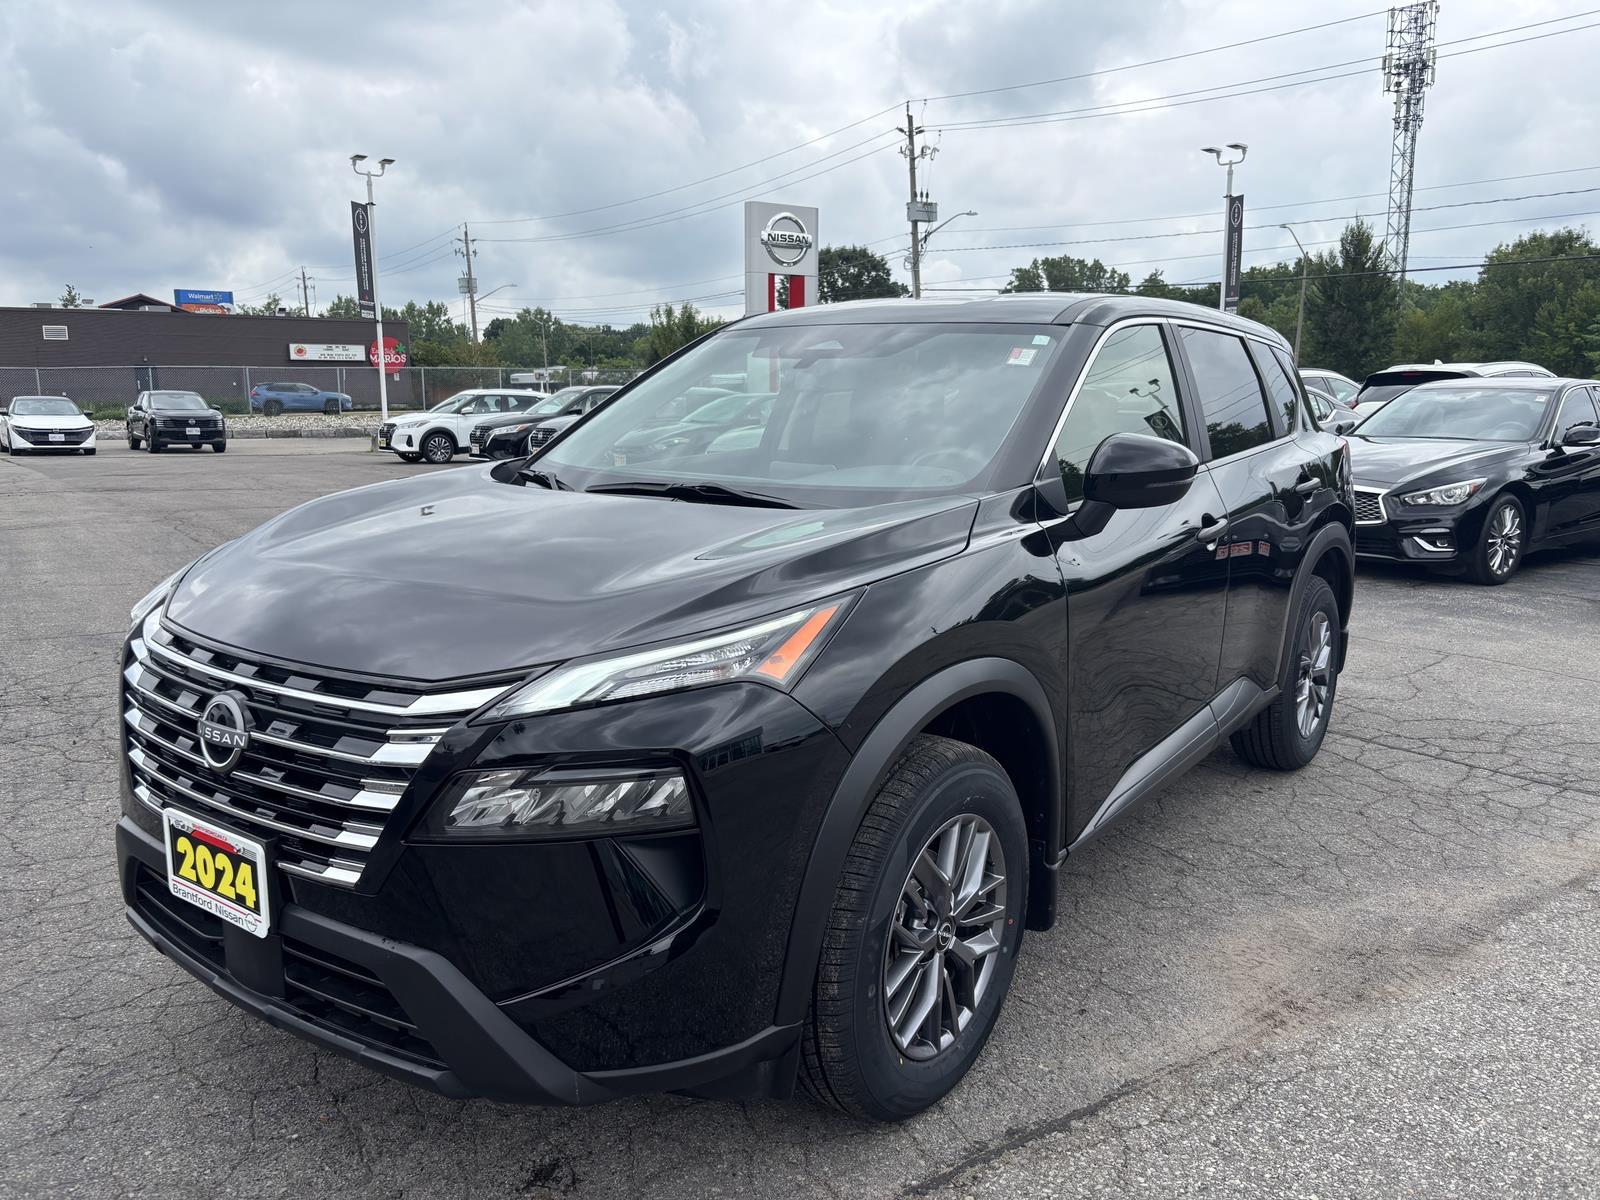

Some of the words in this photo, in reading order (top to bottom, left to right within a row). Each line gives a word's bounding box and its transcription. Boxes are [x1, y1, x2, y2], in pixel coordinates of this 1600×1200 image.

[767, 233, 809, 245] NISSAN
[176, 836, 256, 909] 2024
[172, 883, 213, 910] Brantford
[215, 903, 244, 926] Nissan
